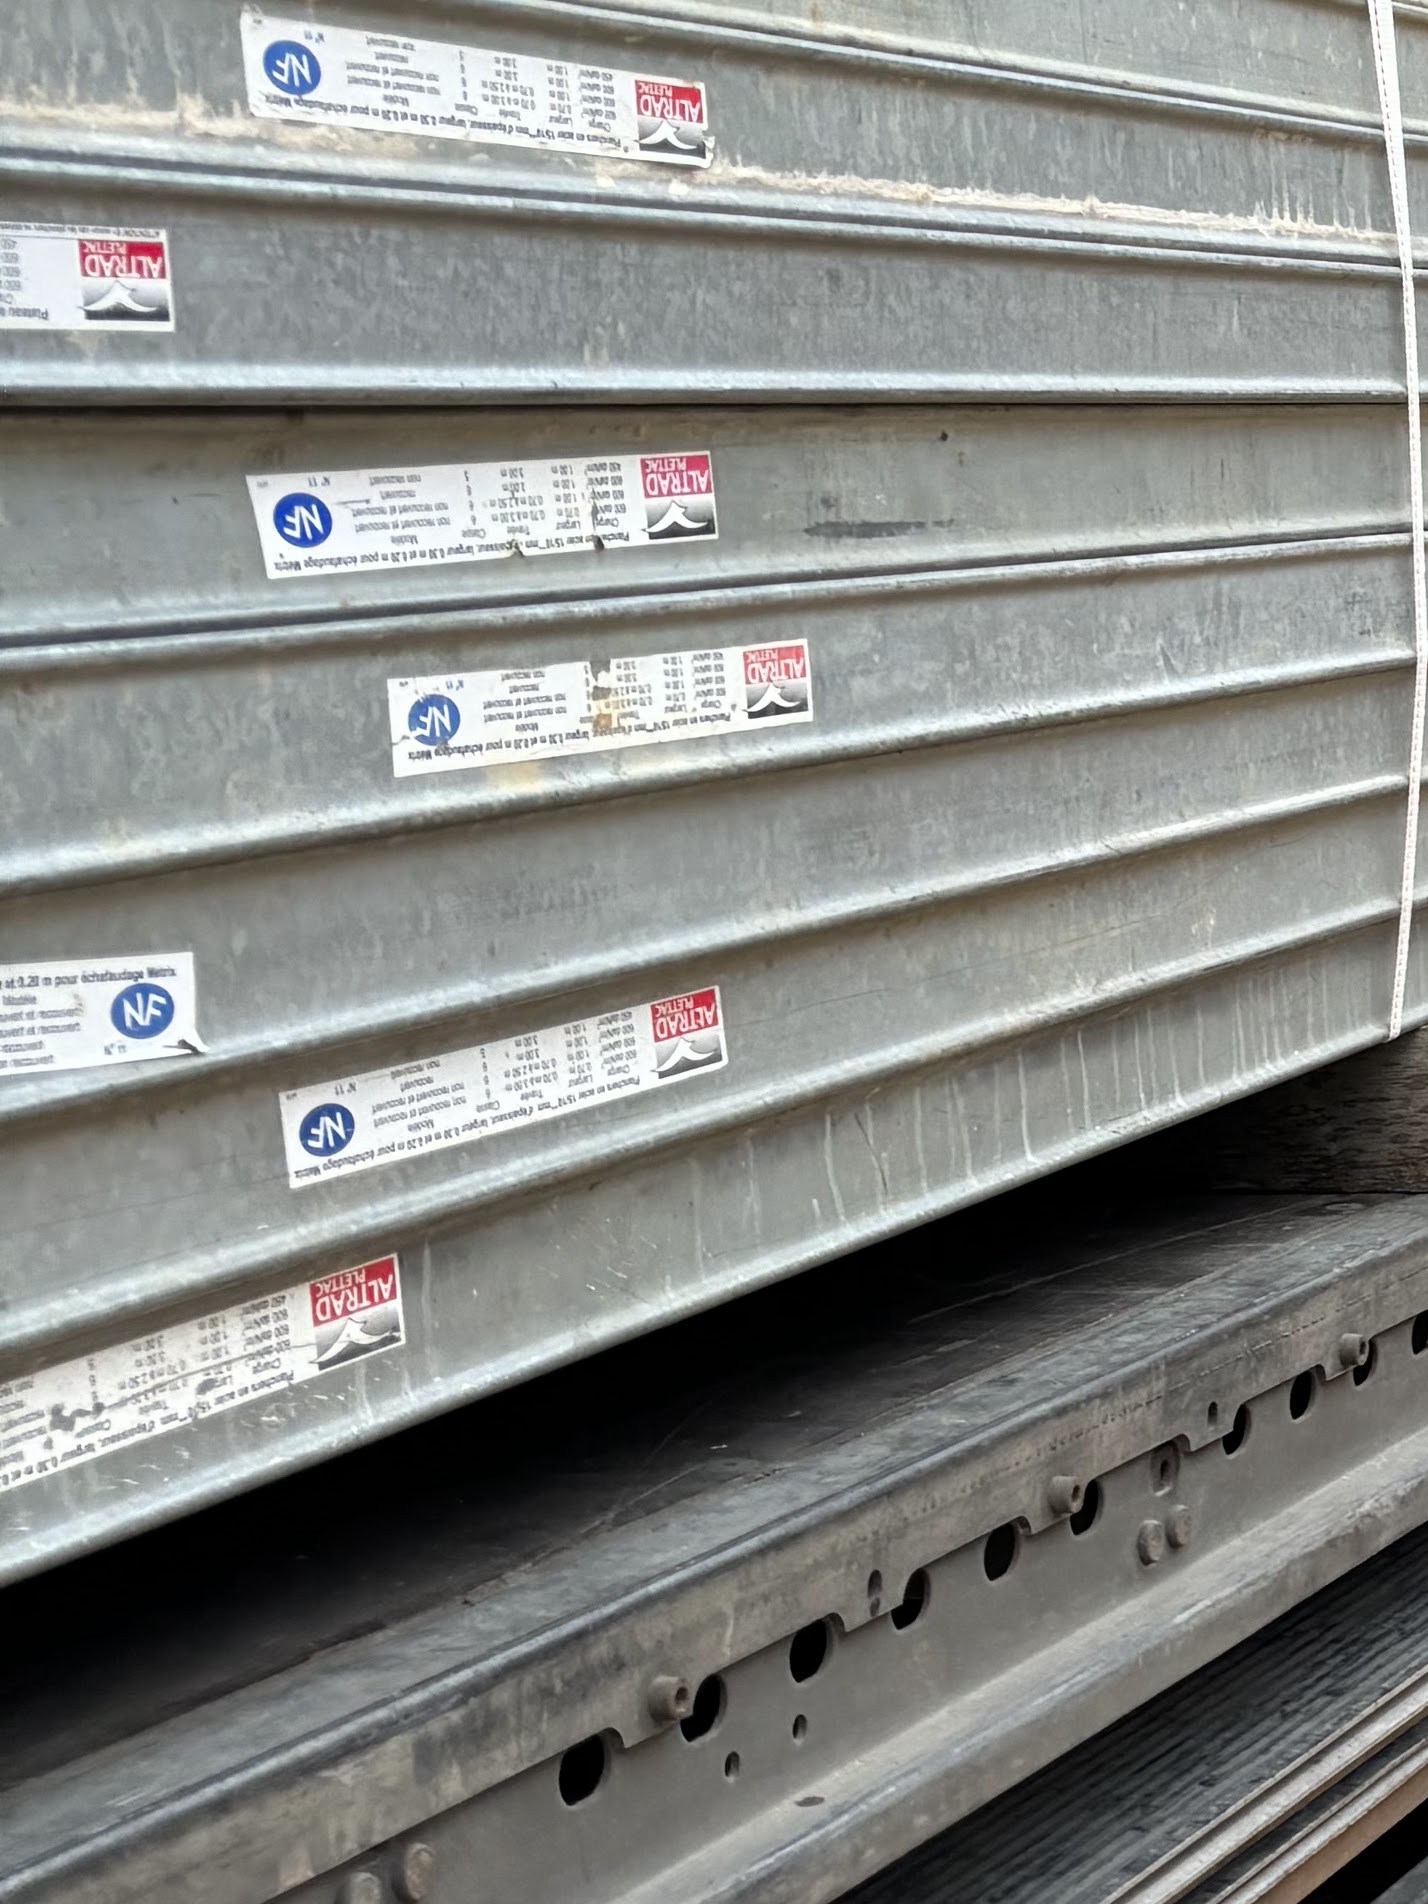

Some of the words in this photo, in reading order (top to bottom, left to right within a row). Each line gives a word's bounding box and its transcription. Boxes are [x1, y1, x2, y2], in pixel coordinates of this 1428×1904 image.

[269, 49, 312, 88] NF
[637, 80, 673, 97] PLETTAC
[638, 92, 701, 122] ALTRAD
[84, 254, 162, 277] ALTRAD
[644, 458, 686, 472] PLETTAC
[644, 469, 709, 495] ALTRAD
[278, 504, 325, 541] NF
[746, 656, 804, 683] ALTRAD
[408, 703, 452, 740] NF
[122, 990, 168, 1029] NF
[653, 995, 693, 1017] PLETTAC
[654, 1003, 717, 1039] ALTRAD
[303, 1110, 347, 1153] NF
[315, 1269, 365, 1297] PLETTAC
[315, 1274, 393, 1323] ALTRAD
